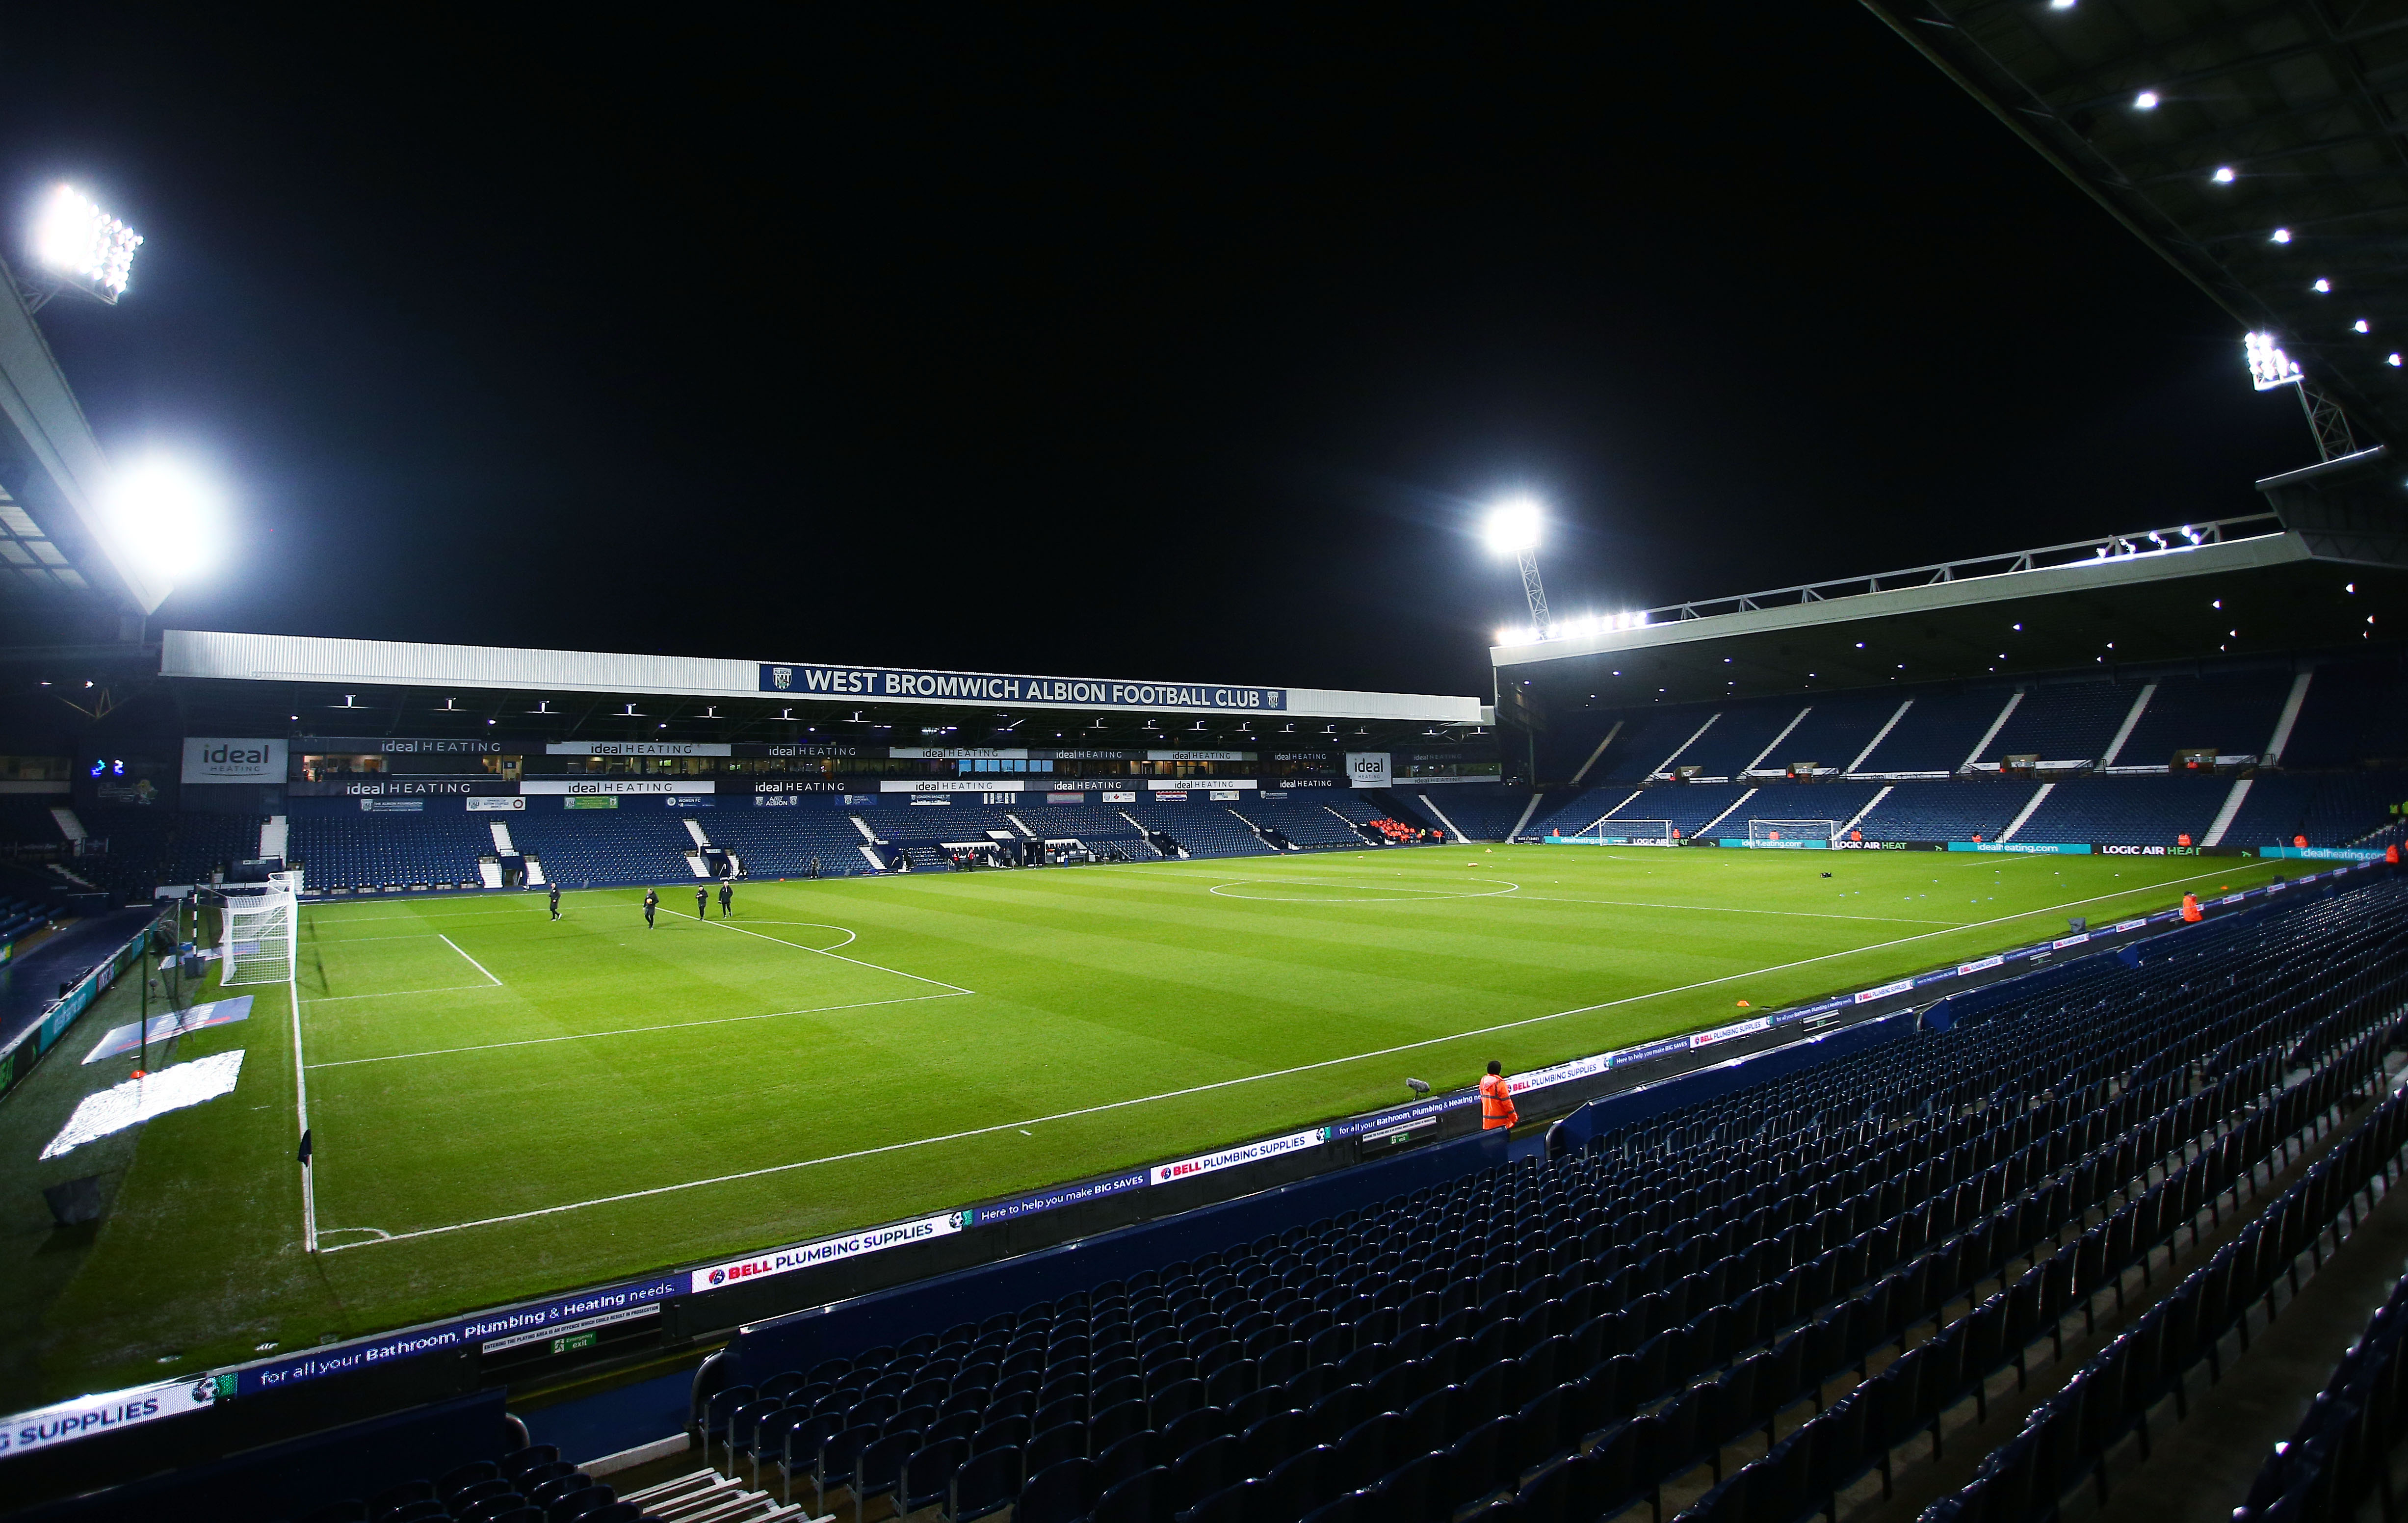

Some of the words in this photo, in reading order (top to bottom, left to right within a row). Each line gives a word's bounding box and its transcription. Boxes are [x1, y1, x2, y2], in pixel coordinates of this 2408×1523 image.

[805, 669, 877, 693] WEST
[886, 674, 1019, 699] BROMWICH
[1026, 681, 1105, 702] ALBION
[1112, 685, 1210, 706] FOOTBALL
[1215, 689, 1260, 708] CLUB
[382, 740, 417, 752] ideal
[423, 742, 500, 752] HEATING
[591, 743, 621, 754] ideal
[626, 745, 692, 754] HEATING
[769, 746, 795, 756] ideal
[800, 747, 856, 756] HEATING
[204, 744, 269, 763] ideal
[923, 748, 945, 758] ideal
[949, 749, 998, 757] HEATING
[1056, 750, 1076, 759] ideal
[1355, 758, 1383, 773] ideal
[347, 783, 384, 794] ideal
[390, 784, 471, 793] HEATING
[569, 783, 600, 793] ideal
[605, 784, 673, 792] HEATING
[756, 782, 783, 792] ideal
[786, 783, 844, 791] HEATING
[916, 781, 939, 791] ideal
[1054, 781, 1075, 790] ideal
[1280, 780, 1296, 788] ideal
[1977, 843, 2058, 853] idealheating.com
[2102, 845, 2140, 854] LOGIC
[2142, 846, 2164, 855] AIR
[2167, 847, 2201, 855] HEAT
[1872, 987, 1890, 997] PLUMBING
[1891, 983, 1906, 992] SUPPLIES
[1714, 1028, 1738, 1039] PLUMBING
[1740, 1022, 1761, 1033] SUPPLIES
[1634, 1052, 1644, 1061] help
[1674, 1041, 1687, 1049] SAVES
[1513, 1081, 1530, 1092] BELL
[1532, 1072, 1566, 1087] PLUMBING
[1568, 1064, 1597, 1077] SUPPLIES
[1339, 1126, 1349, 1135] for
[1350, 1123, 1360, 1132] all
[1361, 1121, 1376, 1131] your
[1377, 1111, 1411, 1126] Bathroom,
[1413, 1103, 1443, 1117] Plumbing
[1449, 1095, 1473, 1107] Heating
[1174, 1161, 1202, 1176] BELL
[1204, 1148, 1257, 1169] PLUMBING
[1260, 1136, 1305, 1155] SUPPLIES
[982, 1208, 1006, 1221] Here
[1009, 1205, 1019, 1213] to
[1022, 1199, 1044, 1211] help
[1046, 1195, 1064, 1208] you
[1066, 1188, 1092, 1201] make
[1095, 1182, 1112, 1194] BIG
[1114, 1175, 1143, 1190] SAVES
[729, 1260, 772, 1279] BELL
[776, 1240, 860, 1268] PLUMBING
[864, 1223, 933, 1248] SUPPLIES
[484, 1339, 506, 1350] ENTERING
[517, 1333, 535, 1342] PLAYING
[561, 1323, 580, 1331] OFFENCE
[610, 1313, 625, 1321] RESULT
[631, 1306, 659, 1315] PROSECUTION
[261, 1370, 287, 1387] for
[294, 1361, 314, 1378] all
[319, 1354, 362, 1374] your
[366, 1331, 459, 1362] Bathroom,
[465, 1310, 545, 1339] Plumbing
[549, 1308, 559, 1318] &
[565, 1293, 625, 1316] Heating
[630, 1283, 675, 1301] needs.
[566, 1333, 593, 1343] Emergency
[573, 1339, 587, 1348] exit
[20, 1398, 158, 1445] SUPPLIES
